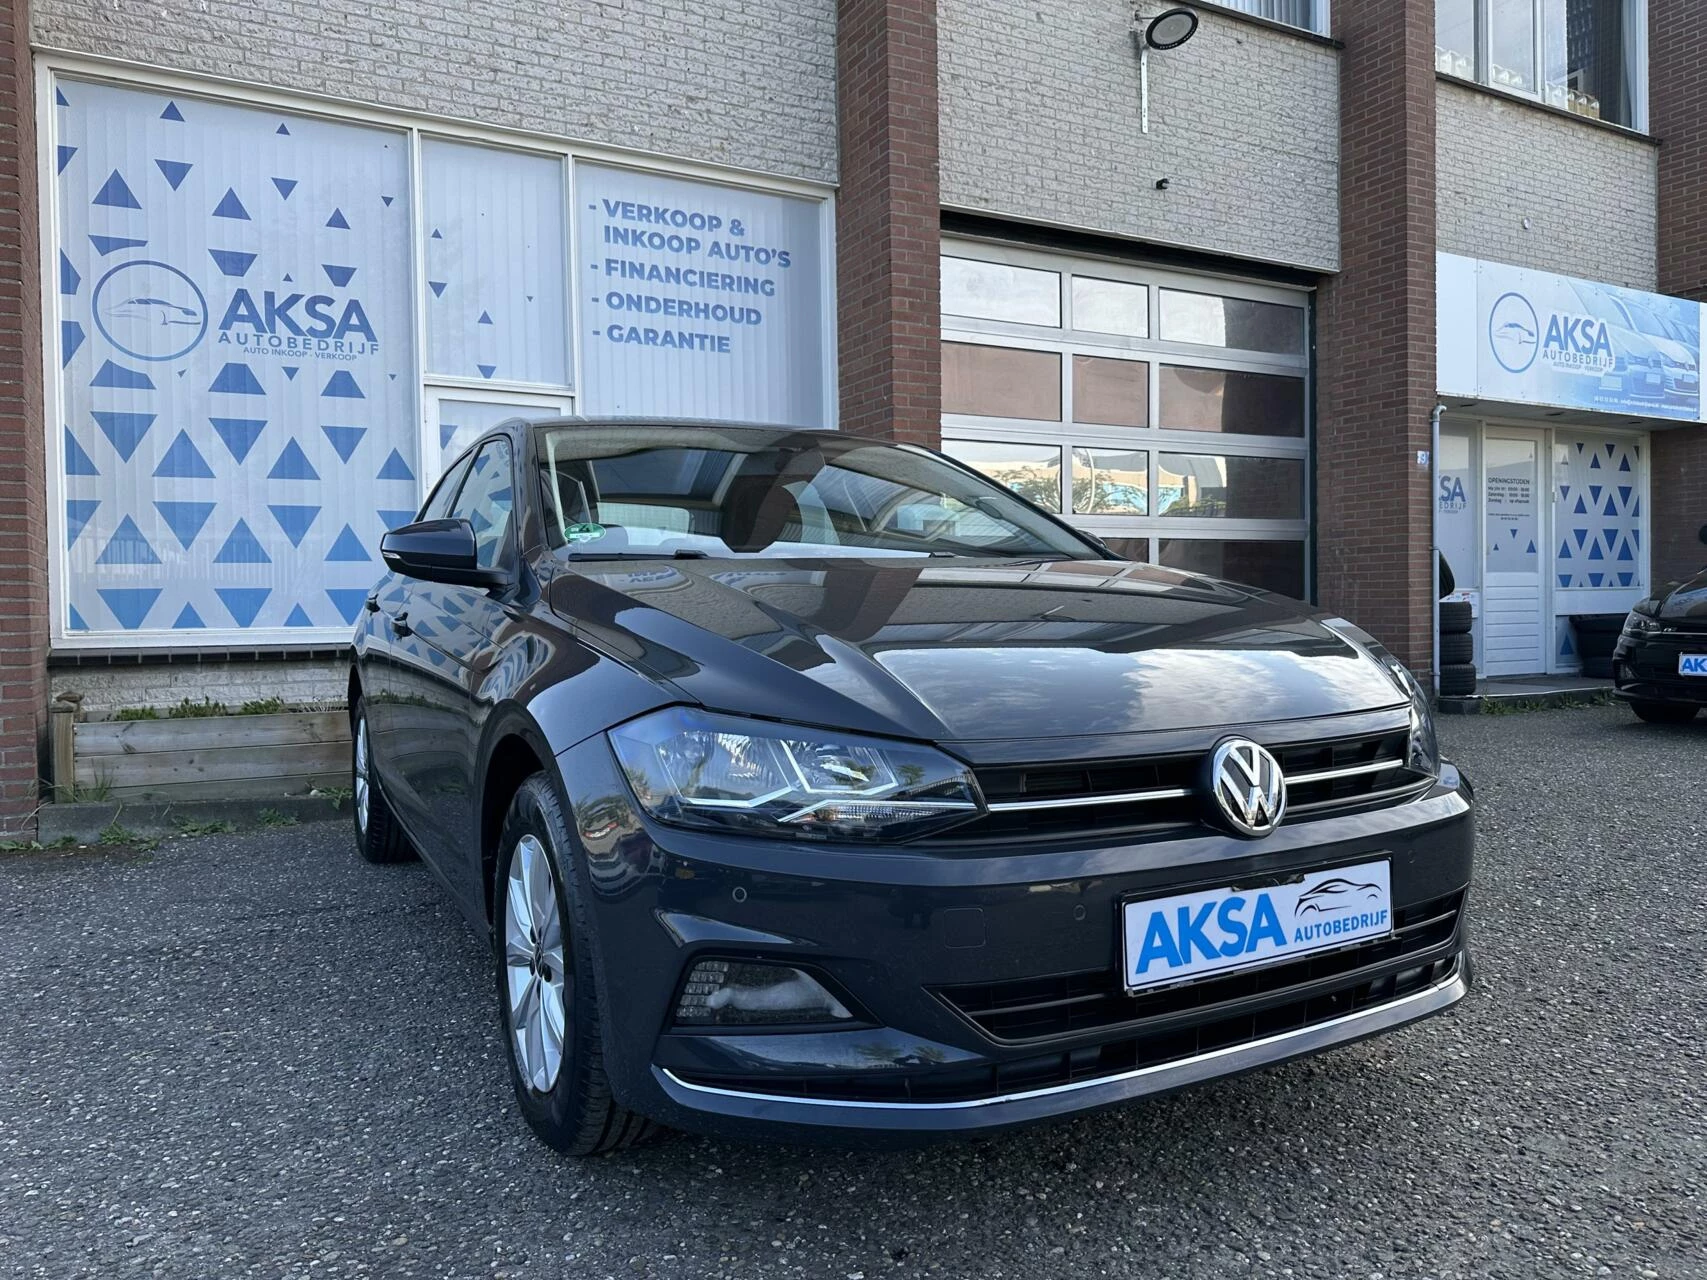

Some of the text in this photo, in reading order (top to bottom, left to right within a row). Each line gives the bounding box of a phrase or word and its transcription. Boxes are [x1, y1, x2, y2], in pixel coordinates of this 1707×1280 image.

[602, 199, 722, 232] VERKOOP
[729, 218, 745, 237] &
[604, 225, 791, 268] INKOOP AUTO'S
[605, 258, 775, 297] FINANCIERING
[218, 288, 378, 342] AKSA
[606, 291, 762, 325] ONDERHOUD
[218, 331, 379, 356] AUTOBEDRIJF
[243, 346, 269, 355] AUTO
[271, 349, 308, 358] INKOOP
[315, 352, 357, 361] VERKOOP
[607, 324, 731, 353] GARANTIE
[1543, 314, 1612, 357] AKSA
[1543, 350, 1613, 369] AUTOBEDRIJF
[1439, 475, 1466, 502] SA
[1135, 893, 1388, 974] AKSA AUTOBEDRIJF
